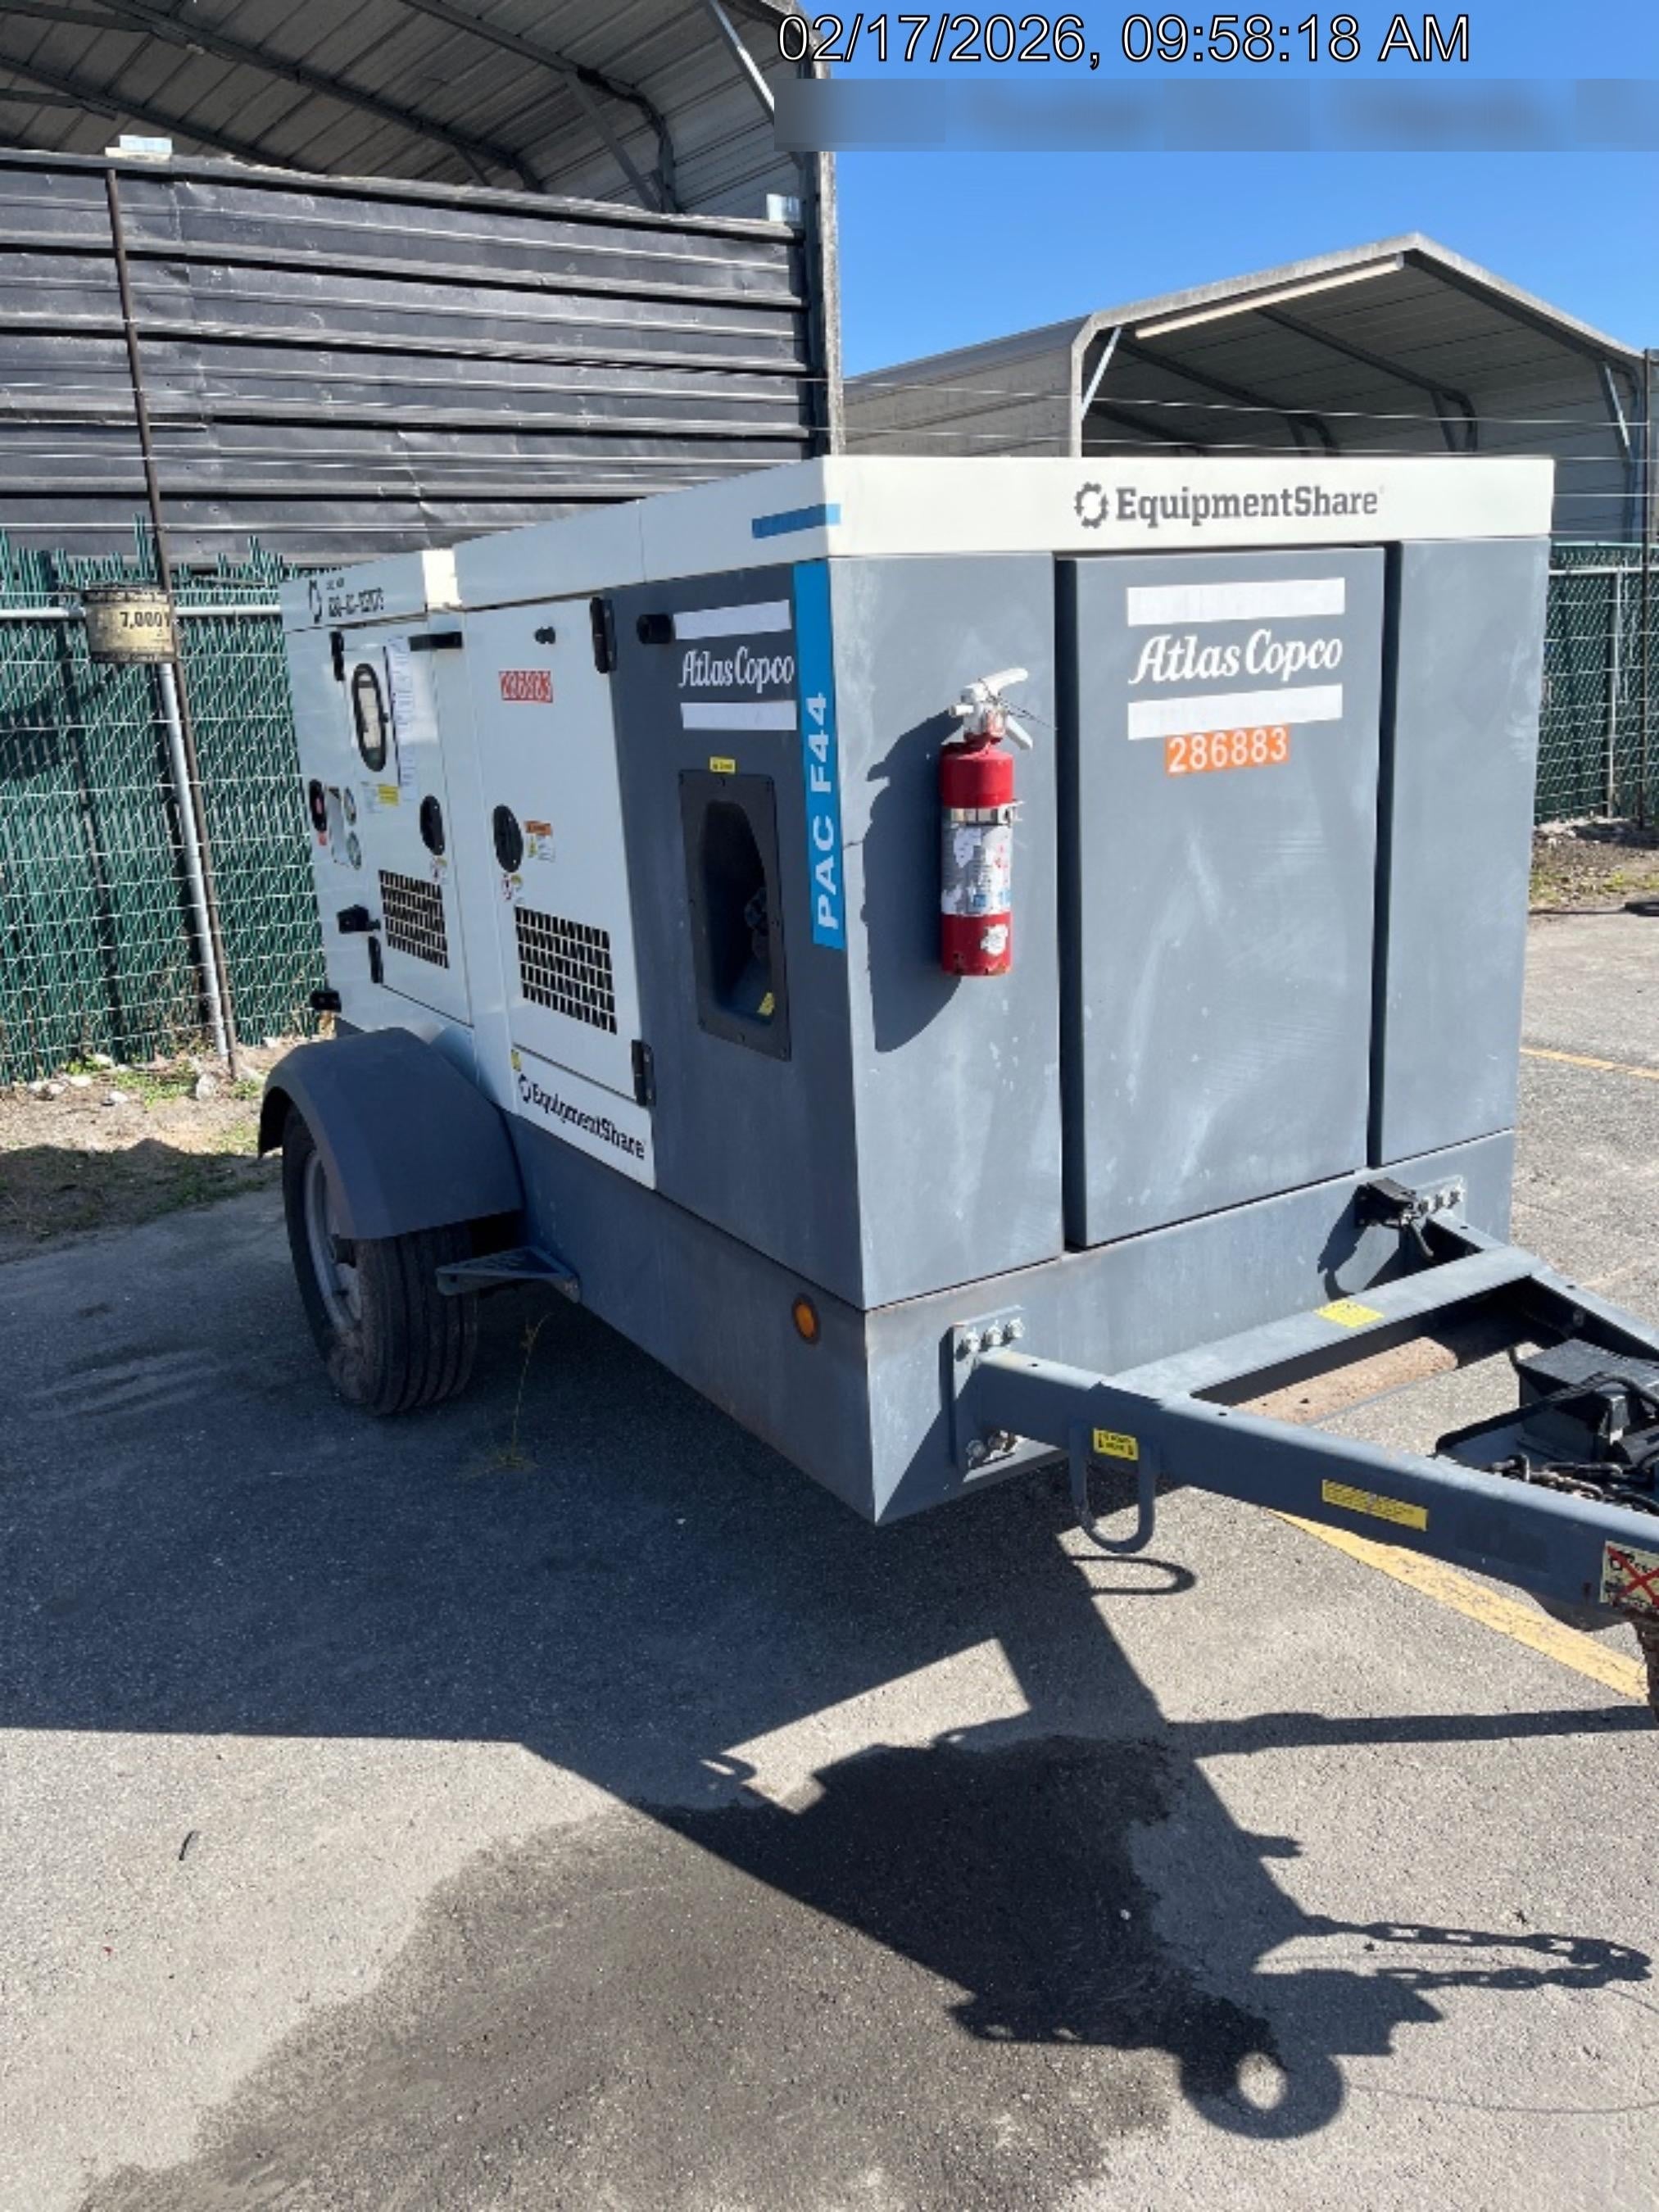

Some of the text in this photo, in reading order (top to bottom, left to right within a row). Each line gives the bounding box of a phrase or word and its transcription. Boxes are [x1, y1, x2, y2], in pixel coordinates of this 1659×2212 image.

[1116, 486, 1378, 528] EquipmentShare
[678, 646, 795, 694] Atlas Copco
[1127, 628, 1343, 685] Atlas Copco
[1168, 727, 1288, 773] 286883
[806, 692, 838, 929] PAC F44
[532, 1082, 645, 1160] EquipmentShare
